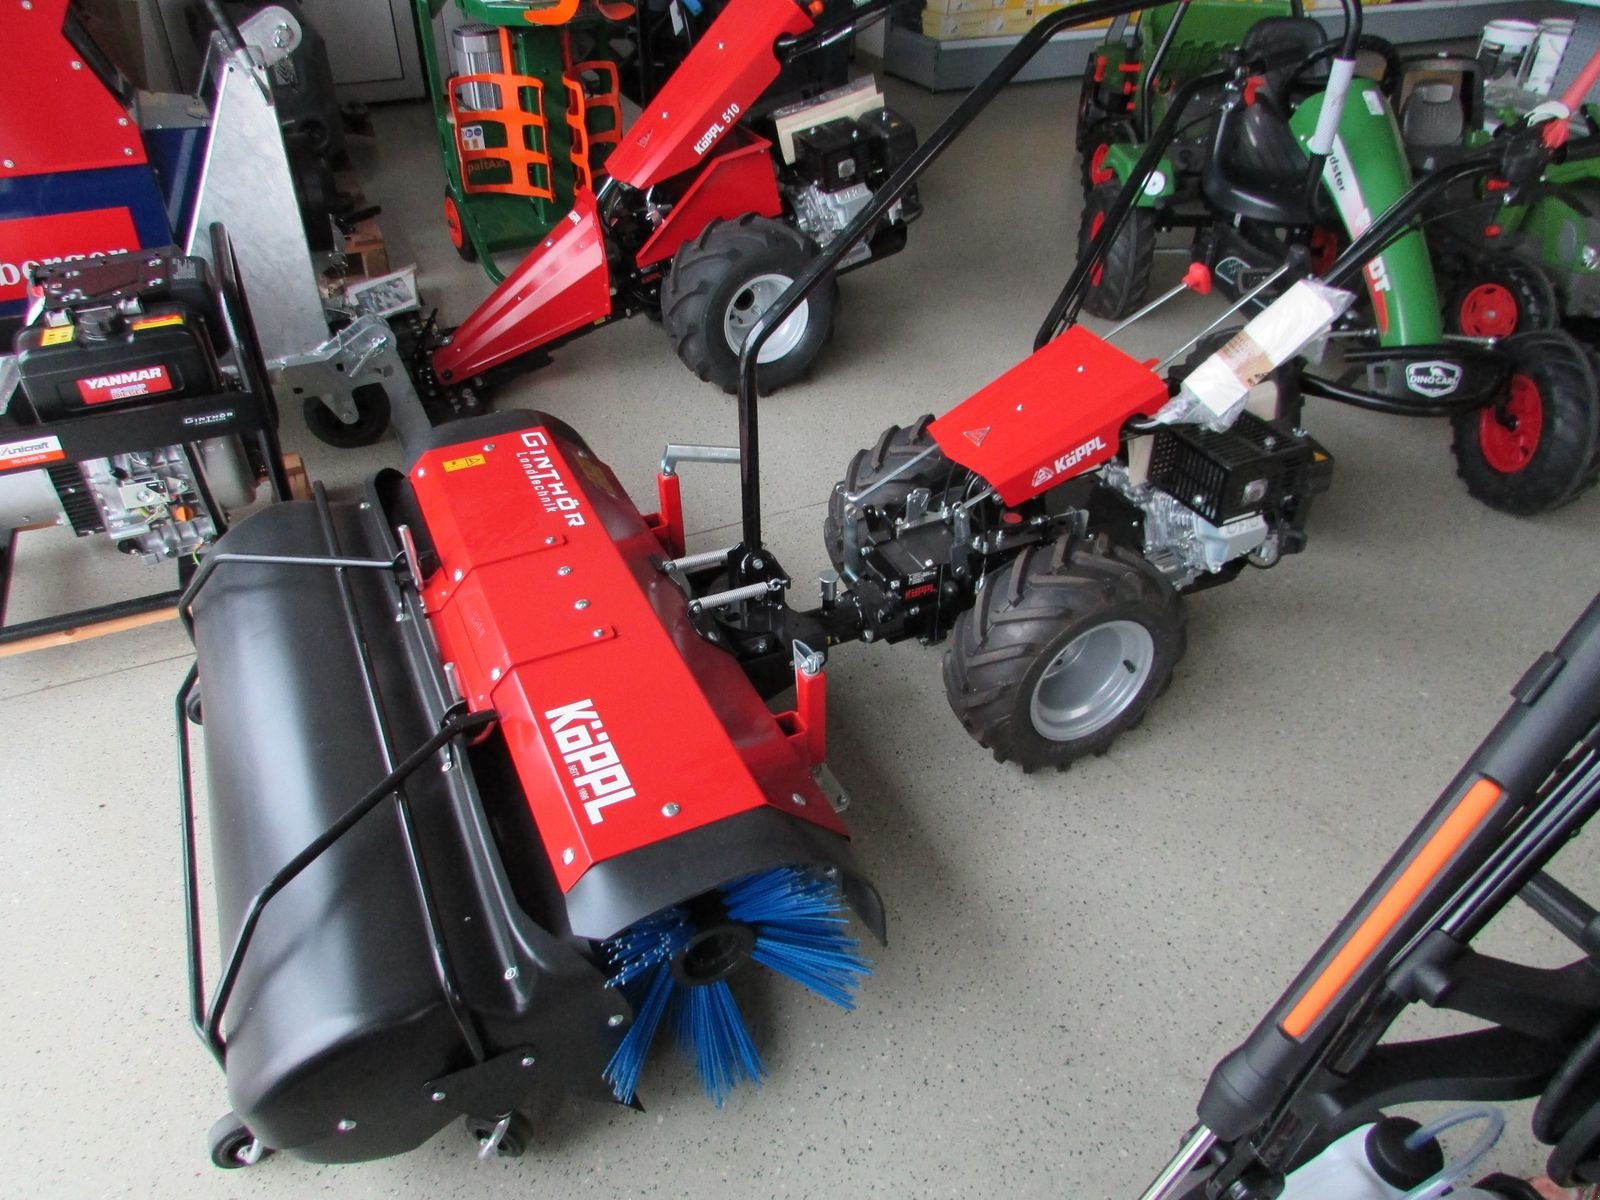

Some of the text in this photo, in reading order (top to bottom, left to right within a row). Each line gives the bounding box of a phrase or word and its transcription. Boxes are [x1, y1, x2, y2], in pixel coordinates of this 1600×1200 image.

[722, 103, 740, 123] 510
[85, 367, 162, 389] YANMAR
[516, 451, 557, 513] Landtechnik
[521, 431, 586, 527] GINTHÖR
